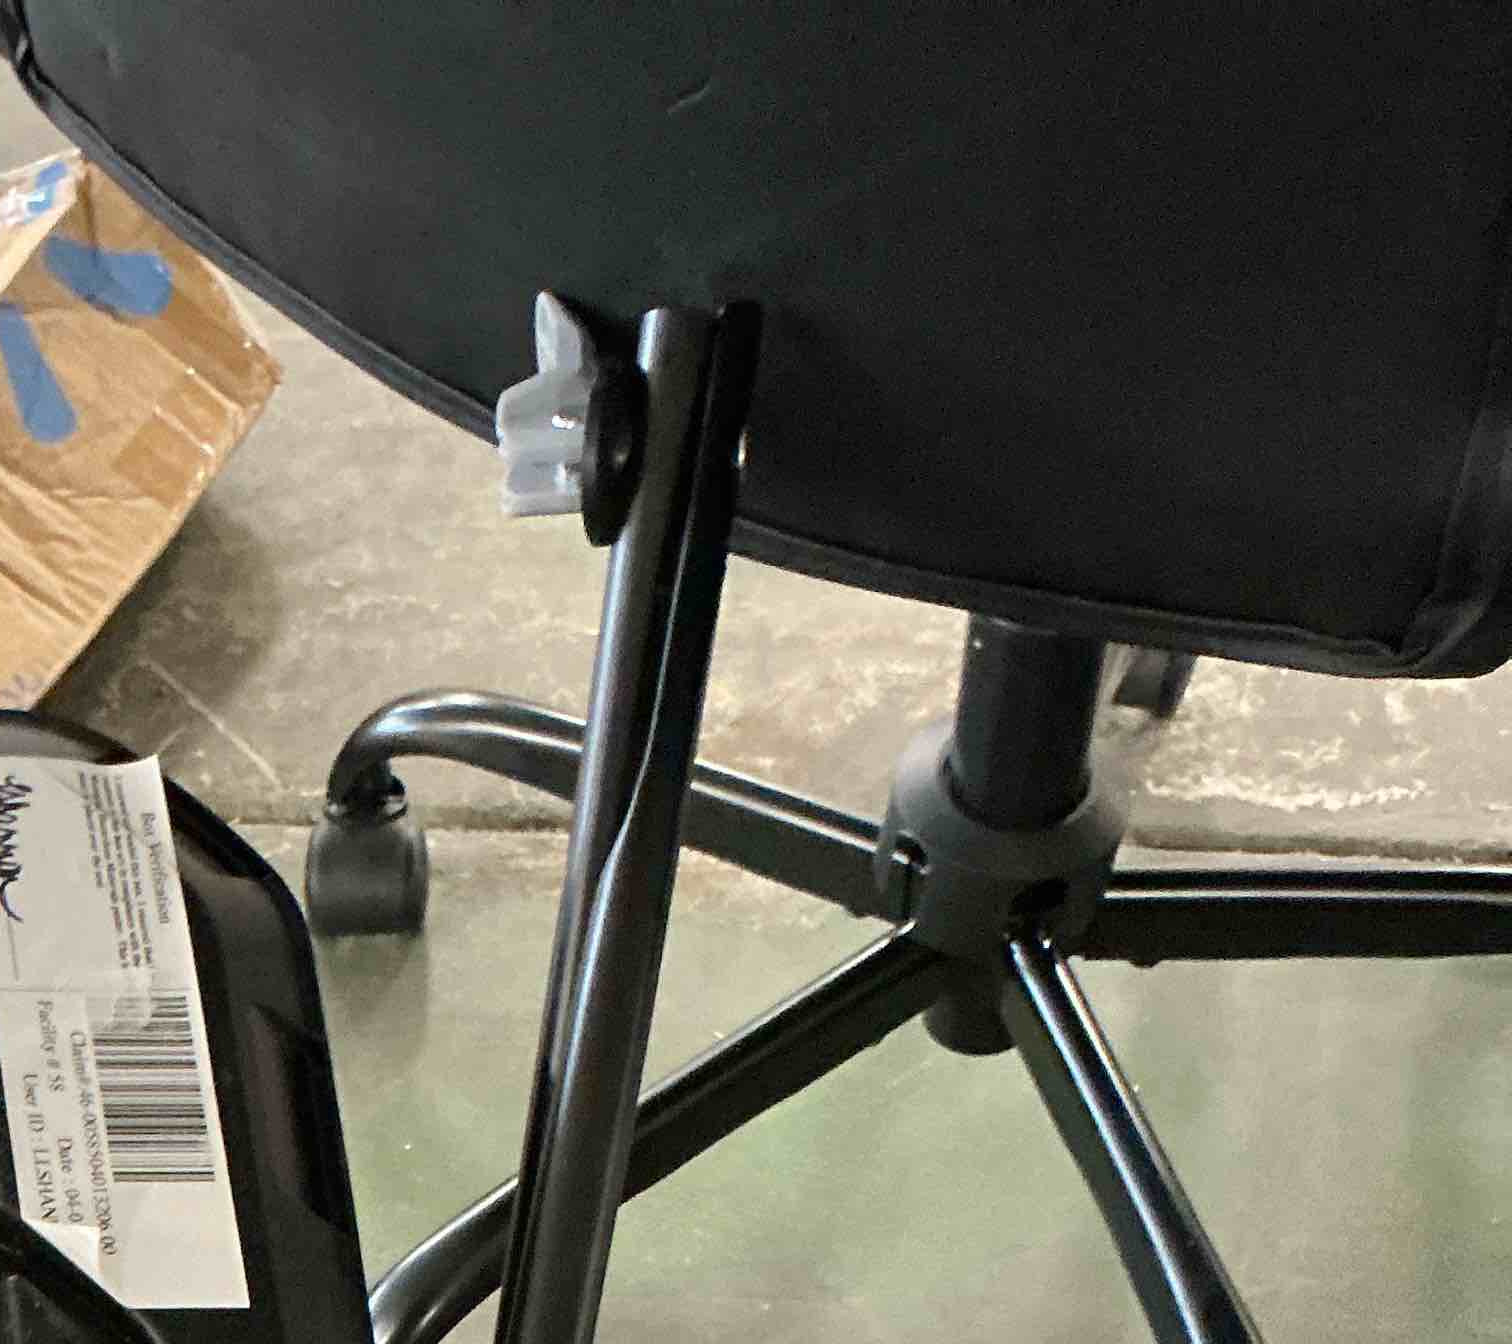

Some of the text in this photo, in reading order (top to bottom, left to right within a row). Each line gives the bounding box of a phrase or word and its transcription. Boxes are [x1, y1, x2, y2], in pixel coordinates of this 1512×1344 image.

[150, 841, 171, 924] Verification
[37, 1000, 57, 1053] Facility
[23, 1073, 40, 1107] User
[27, 1113, 45, 1133] ID
[57, 1137, 73, 1174] Date
